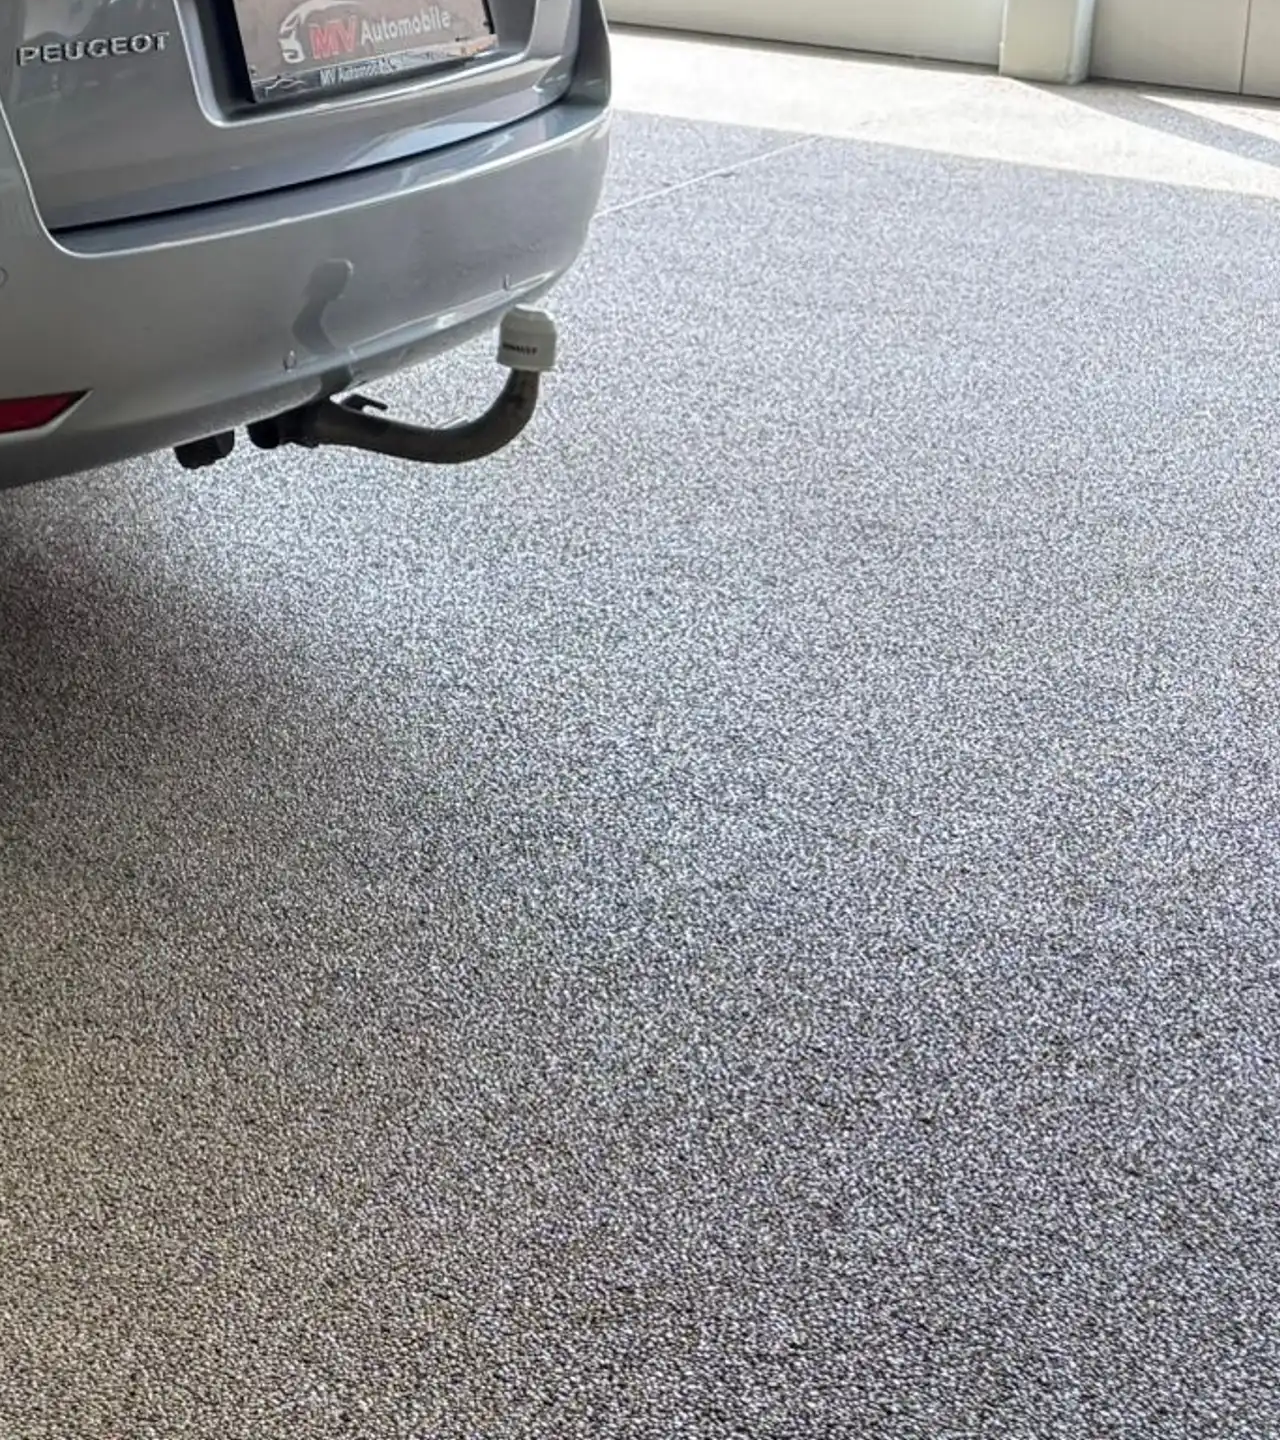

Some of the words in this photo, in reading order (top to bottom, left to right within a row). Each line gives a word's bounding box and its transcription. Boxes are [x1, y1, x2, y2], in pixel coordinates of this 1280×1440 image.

[17, 31, 170, 67] PEUGEOT
[308, 14, 358, 60] MV
[359, 5, 452, 46] Automobile
